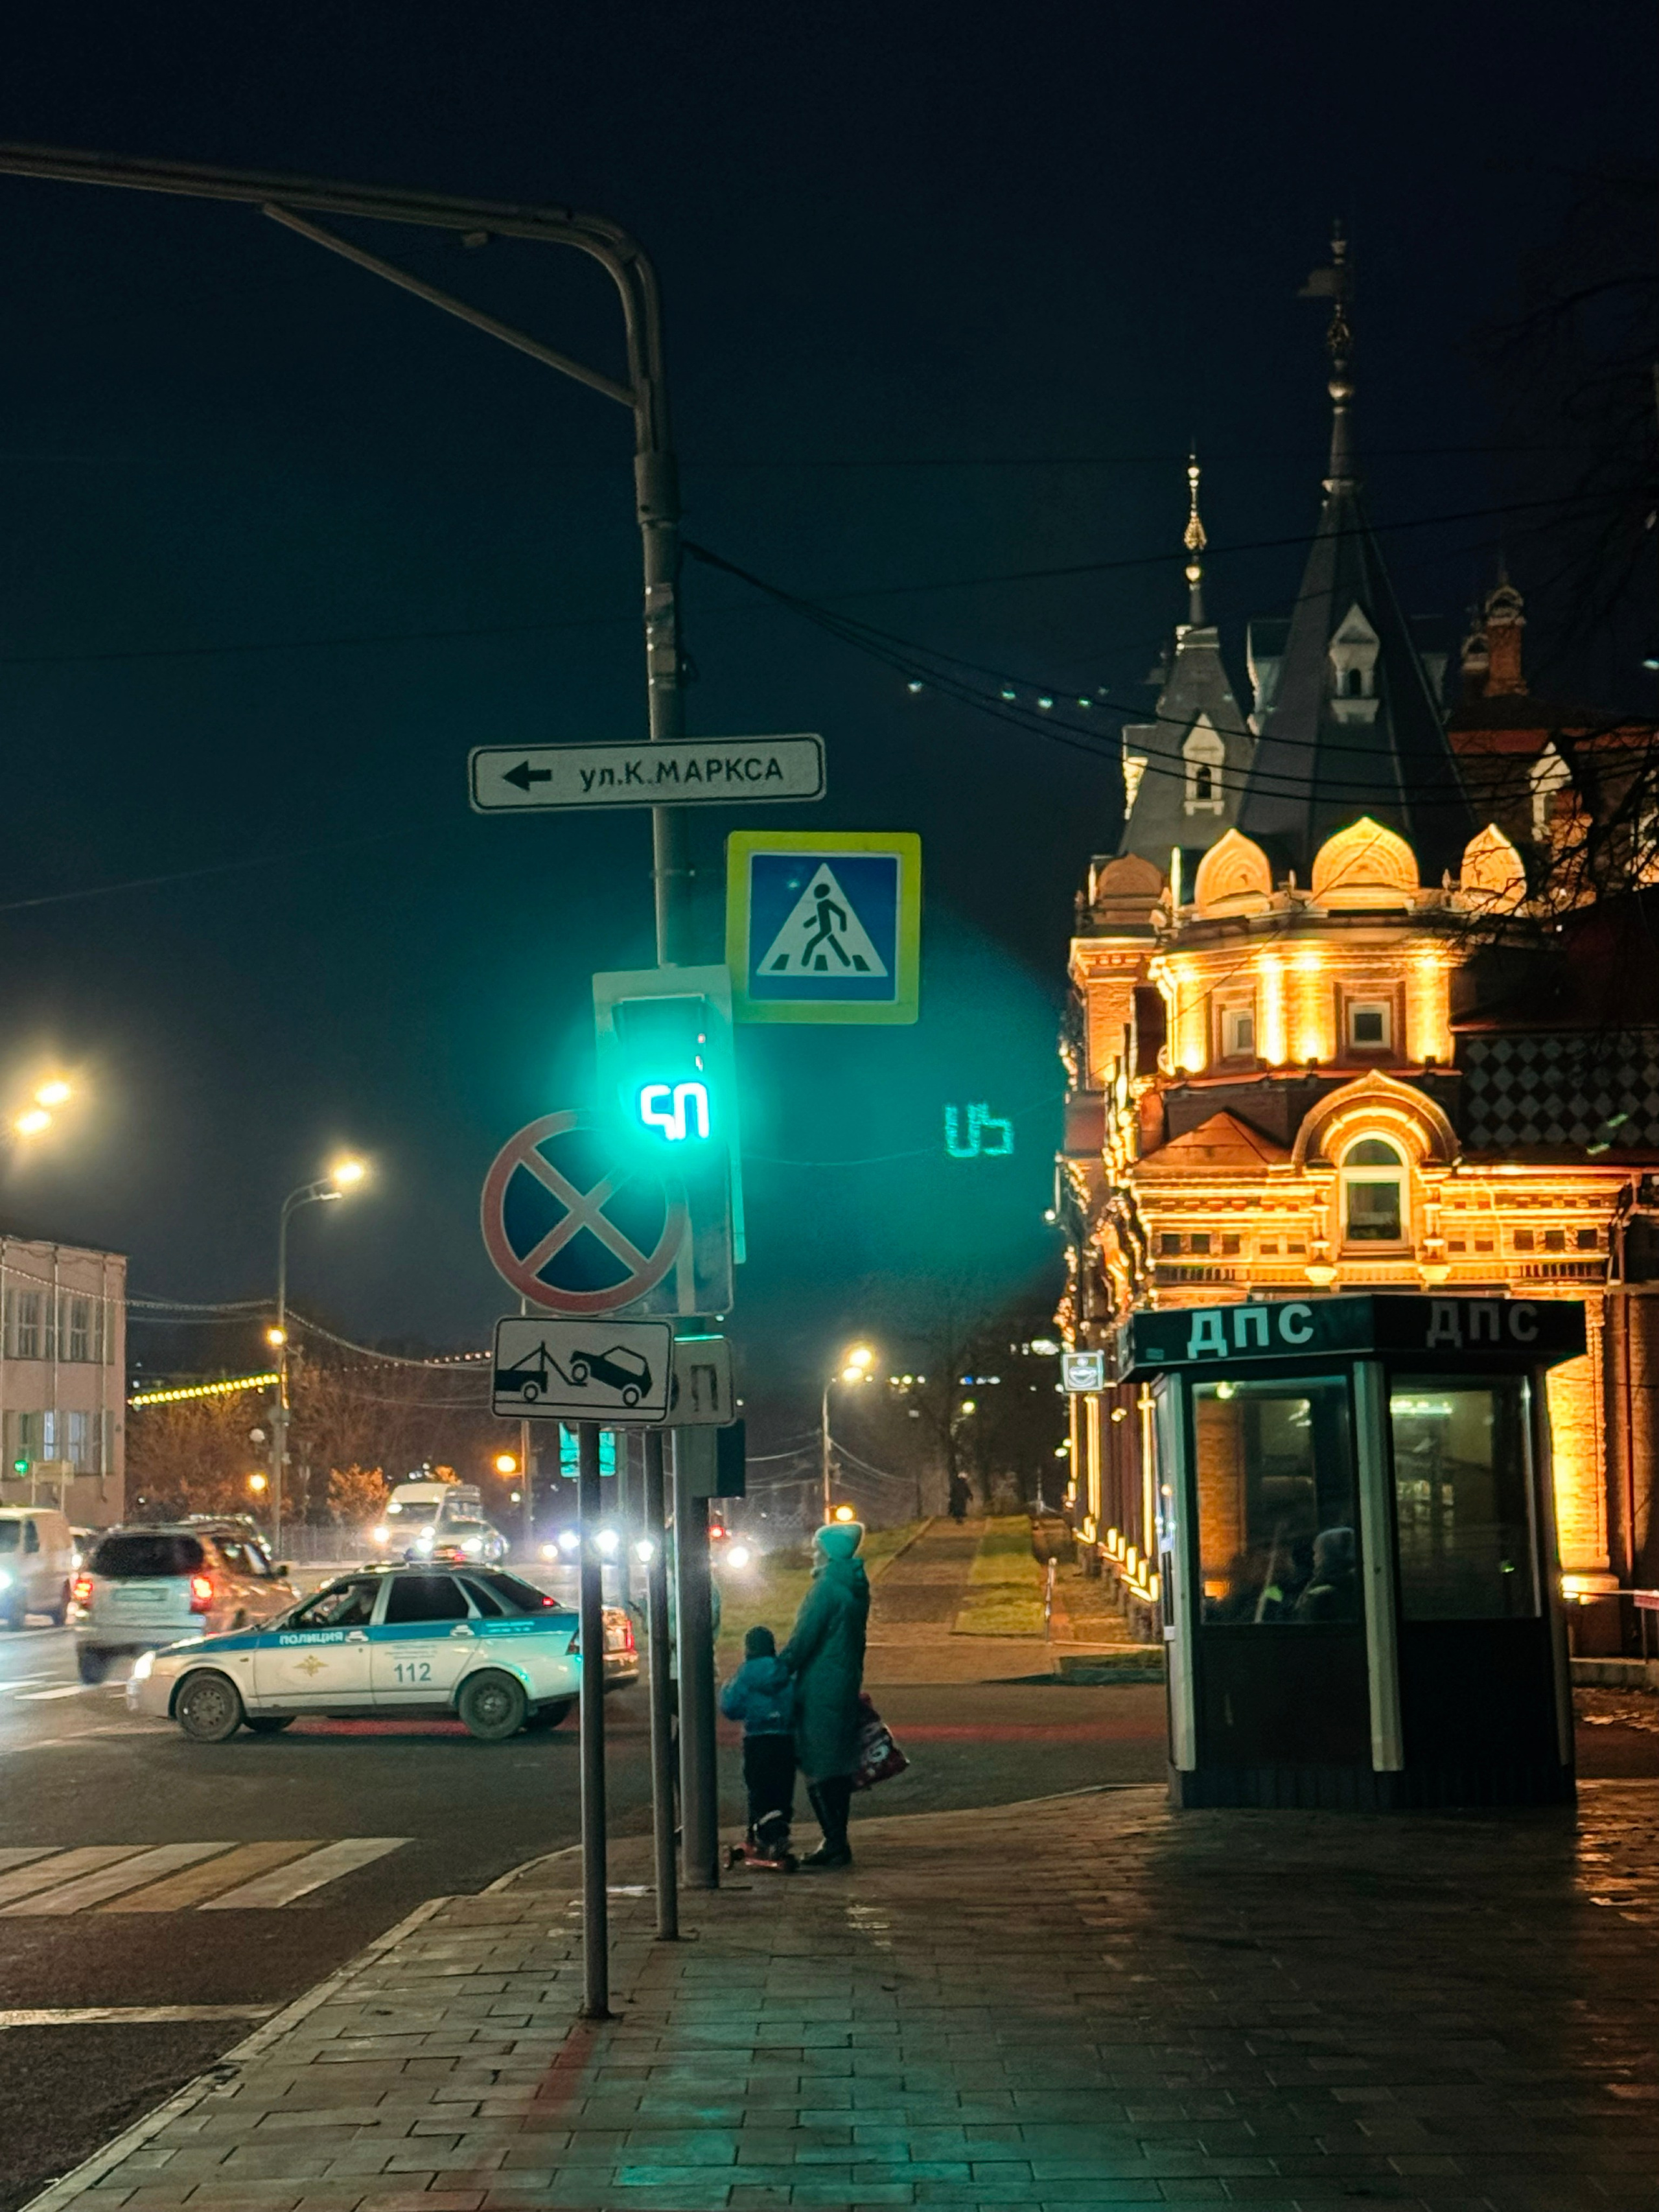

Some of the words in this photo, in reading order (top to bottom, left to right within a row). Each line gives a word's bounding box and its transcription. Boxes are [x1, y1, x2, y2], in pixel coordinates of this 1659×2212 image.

[1187, 1303, 1314, 1359] ДПС
[1426, 1301, 1540, 1348] ДПС
[393, 1662, 432, 1682] 112
